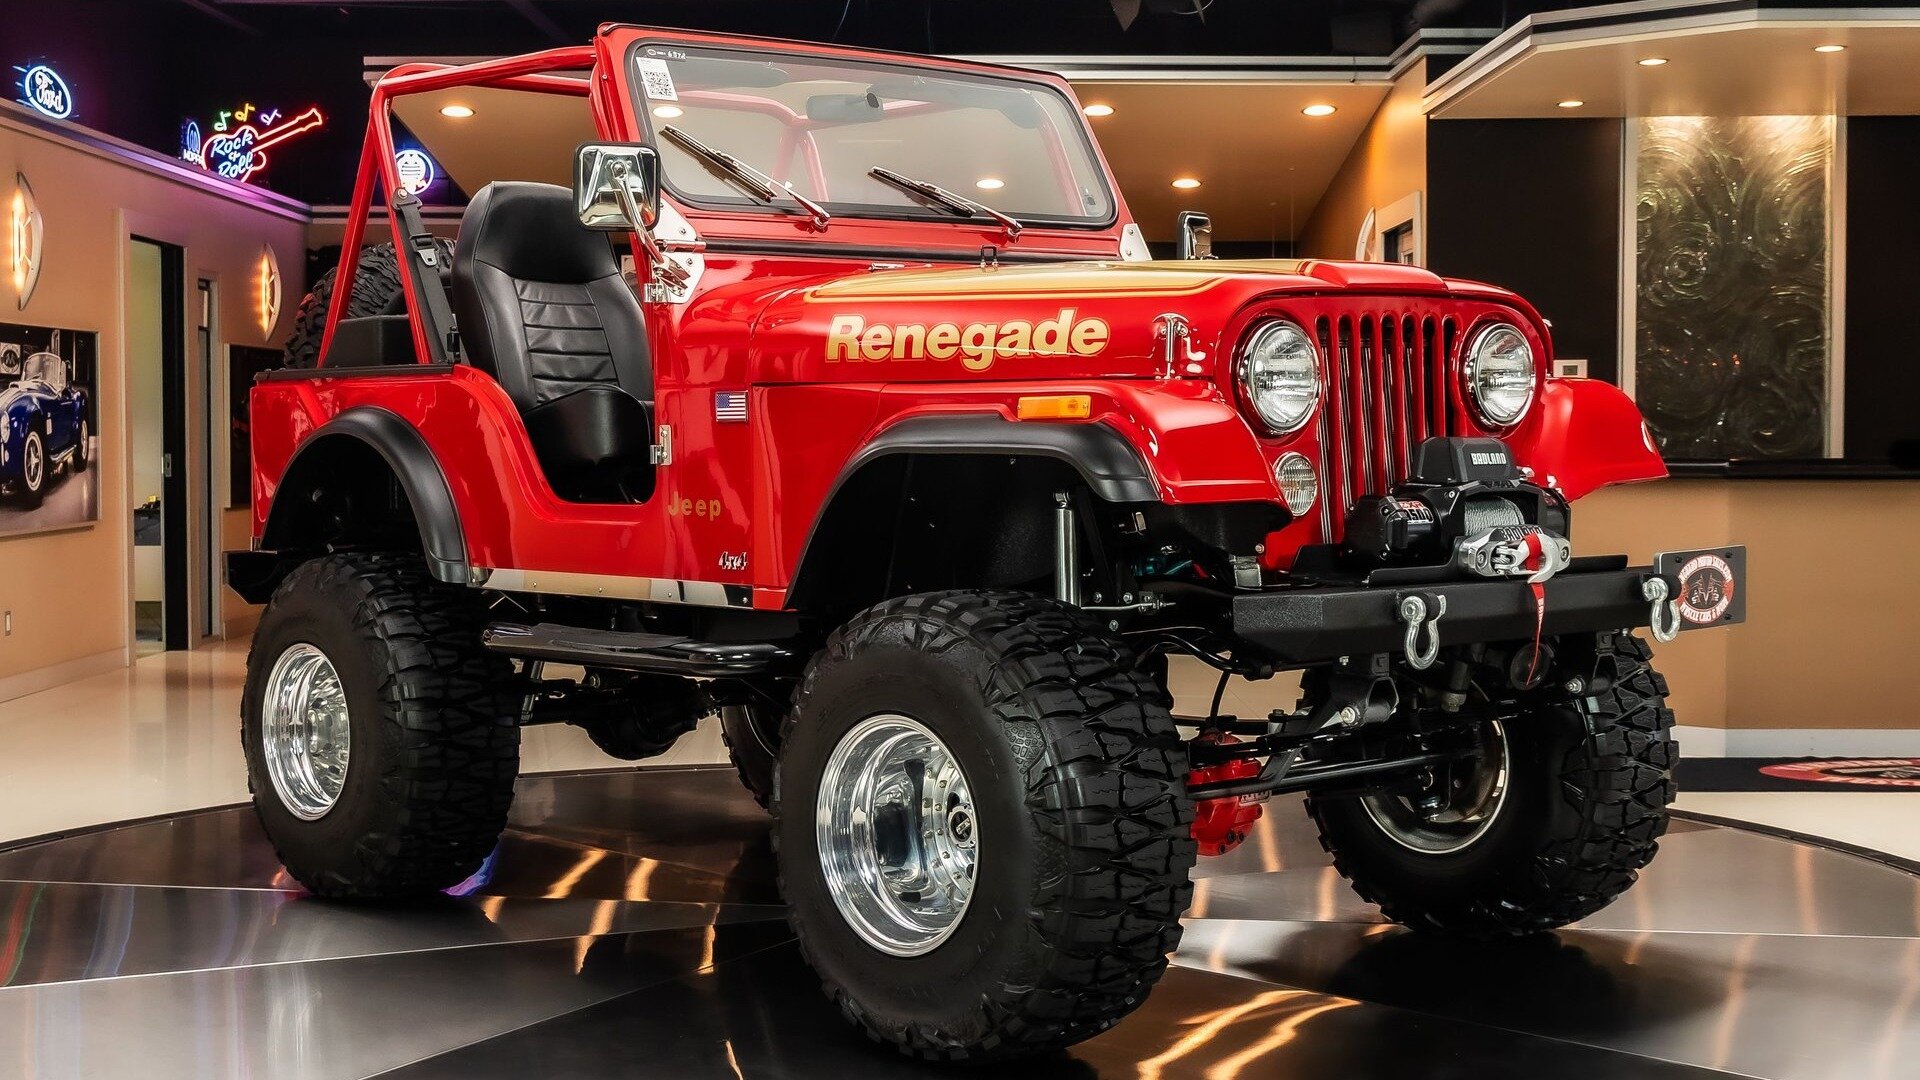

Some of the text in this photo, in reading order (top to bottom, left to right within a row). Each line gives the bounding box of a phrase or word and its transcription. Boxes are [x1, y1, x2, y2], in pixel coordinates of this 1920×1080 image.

[35, 71, 64, 112] Ford
[211, 129, 253, 157] Rock
[218, 151, 254, 178] Roll
[825, 307, 1110, 372] Renegade
[1470, 452, 1507, 465] BADLAND
[668, 491, 721, 521] Jeep
